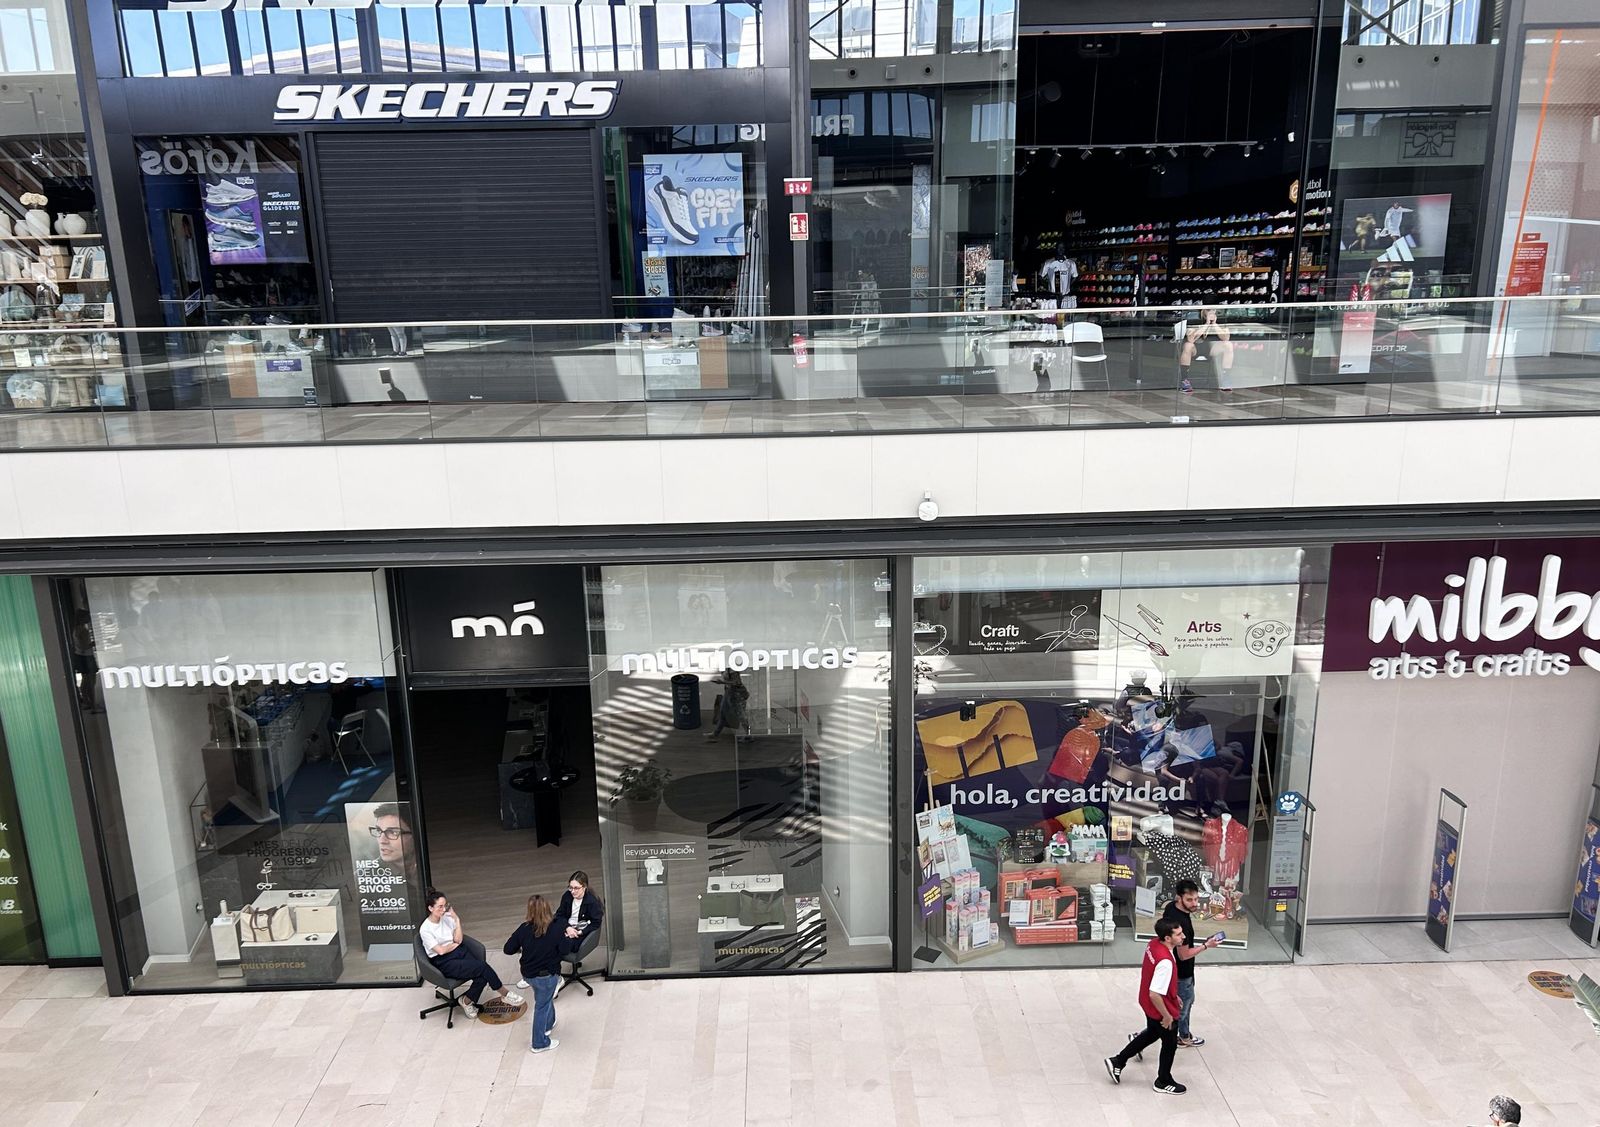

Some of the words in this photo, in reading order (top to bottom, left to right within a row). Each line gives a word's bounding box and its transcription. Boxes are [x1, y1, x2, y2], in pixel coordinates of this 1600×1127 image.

[273, 80, 618, 121] SKECHERS
[690, 187, 742, 208] COZY
[1305, 189, 1331, 200] motion
[696, 207, 735, 229] FIT
[980, 624, 1019, 638] Craft
[1186, 620, 1222, 633] Arts
[1368, 652, 1437, 681] arts
[1443, 649, 1466, 679] &
[1472, 646, 1571, 678] crafts
[950, 783, 1018, 809] hola,
[1024, 780, 1186, 805] creatividad
[1071, 823, 1107, 839] MAMA
[247, 847, 329, 857] PROGRESIVOS
[625, 848, 649, 856] REVISA
[659, 845, 695, 855] AUDICIÓN
[356, 859, 380, 868] MES
[356, 867, 371, 876] DE
[371, 867, 392, 876] LOS
[0, 876, 19, 885] SICS
[357, 876, 406, 885] PROGRE-
[358, 884, 392, 893] SIVOS
[360, 898, 369, 907] 2
[377, 897, 406, 907] 199€
